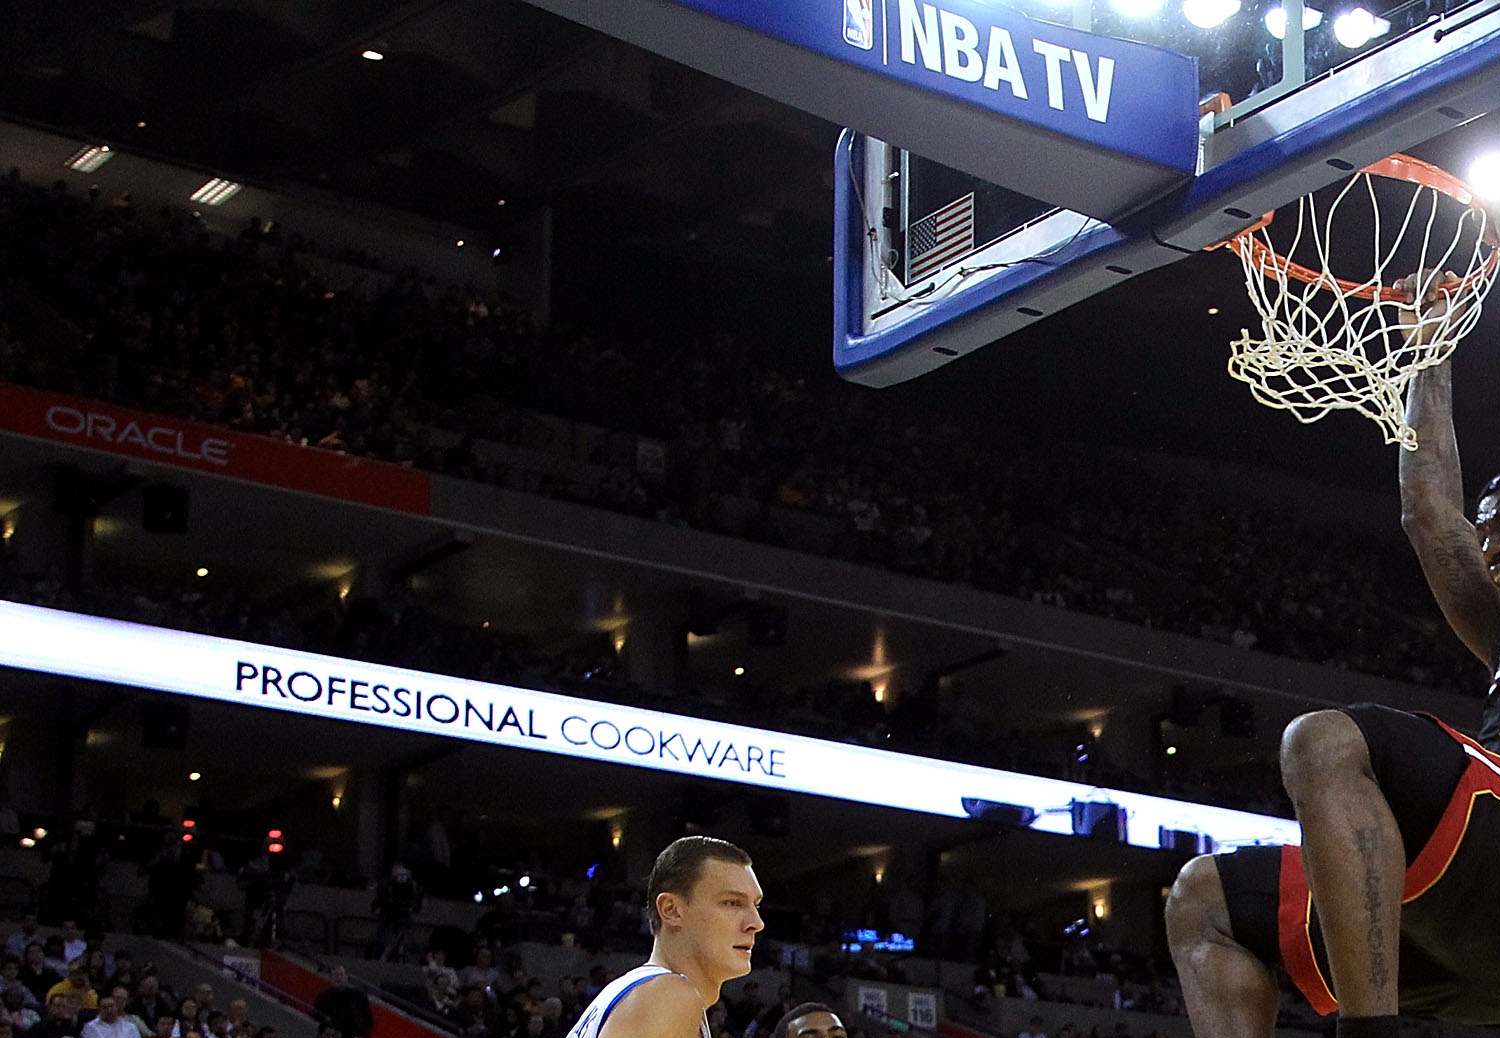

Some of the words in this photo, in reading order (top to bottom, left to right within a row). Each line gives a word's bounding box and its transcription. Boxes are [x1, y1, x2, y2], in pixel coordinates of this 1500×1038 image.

[900, 0, 1028, 100] NBA
[1032, 38, 1115, 124] TV
[45, 405, 232, 465] ORACLE
[235, 660, 548, 740] PROFESSIONAL
[560, 715, 787, 777] COOKWARE
